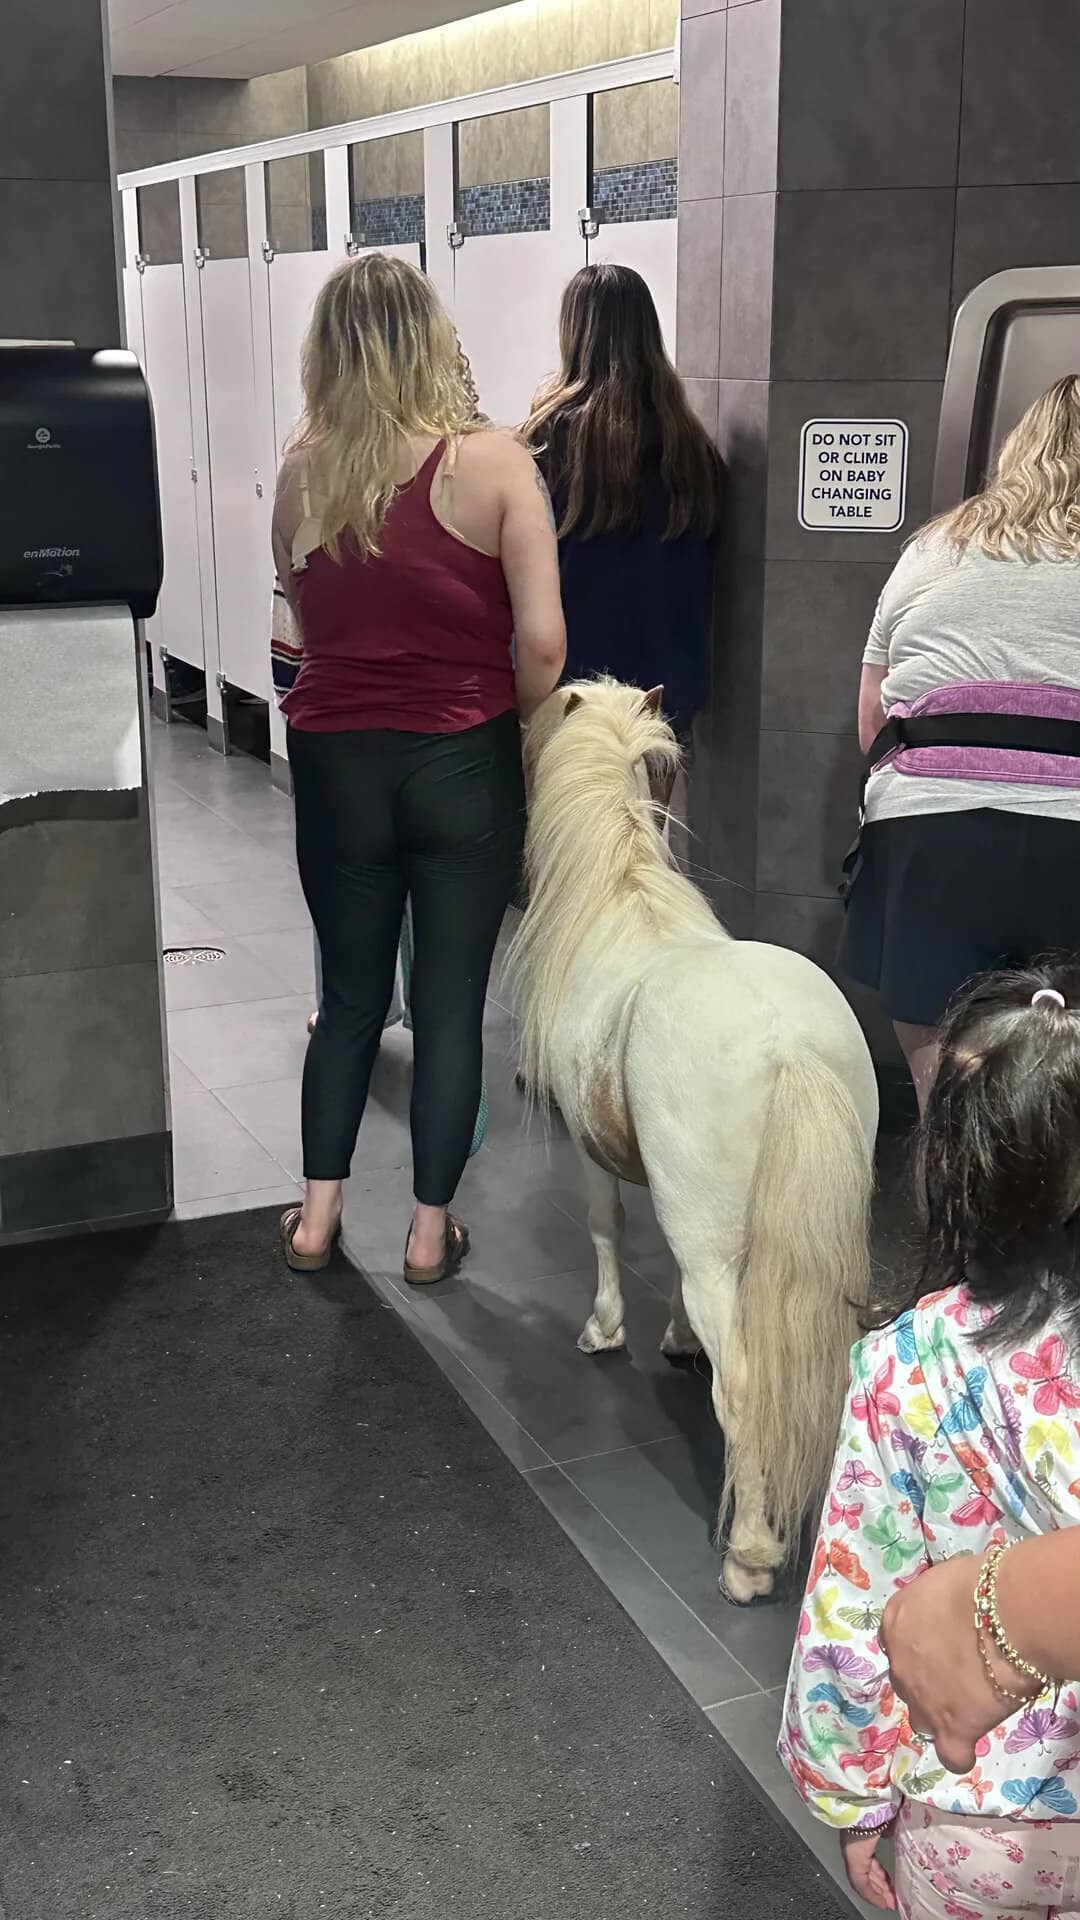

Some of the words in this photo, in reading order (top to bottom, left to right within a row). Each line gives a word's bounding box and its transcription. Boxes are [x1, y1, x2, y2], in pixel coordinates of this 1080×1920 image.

[812, 433, 835, 446] DO
[839, 433, 872, 446] NOT
[874, 434, 897, 447] SIT
[818, 451, 840, 464] OR
[843, 451, 889, 465] CLIMB
[819, 469, 843, 482] ON
[847, 470, 886, 483] BABY
[811, 487, 892, 501] CHANGING
[829, 505, 873, 518] TABLE
[23, 546, 81, 559] enMotion
